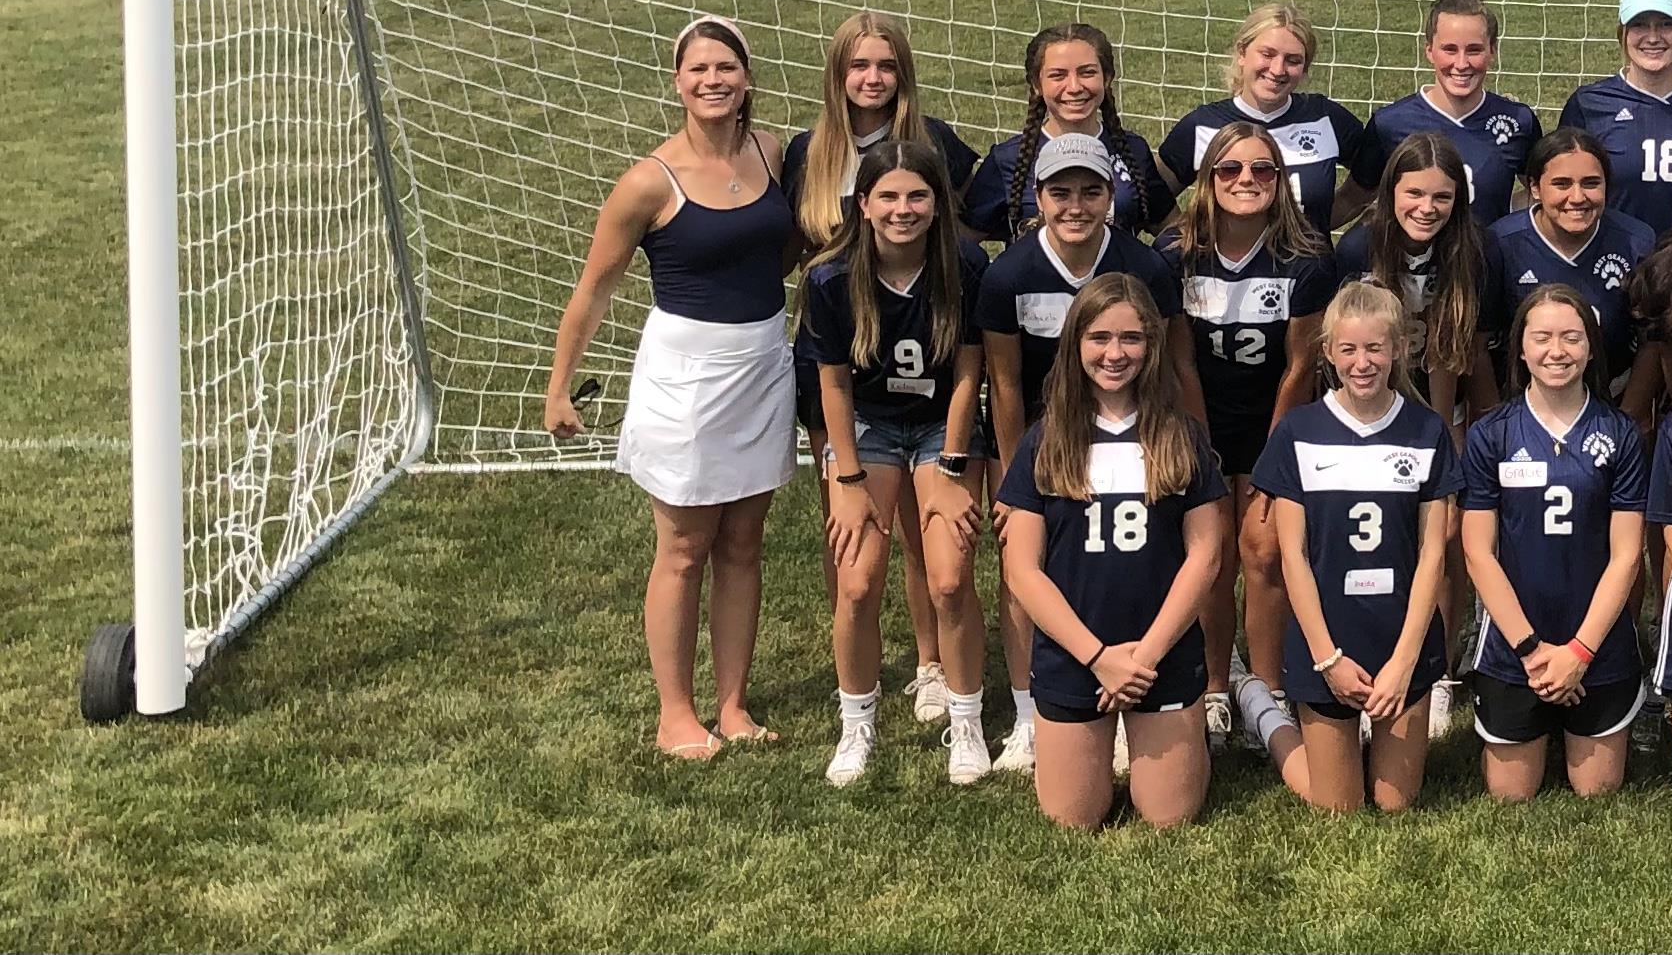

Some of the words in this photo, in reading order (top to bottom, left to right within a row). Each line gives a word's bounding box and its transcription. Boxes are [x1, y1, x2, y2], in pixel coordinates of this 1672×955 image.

[1592, 255, 1607, 275] WEST
[1606, 253, 1632, 274] GEAUGA
[894, 339, 924, 378] 9
[1208, 328, 1266, 365] 12
[1084, 500, 1149, 553] 18
[1348, 501, 1383, 553] 3
[1544, 485, 1573, 535] 2
